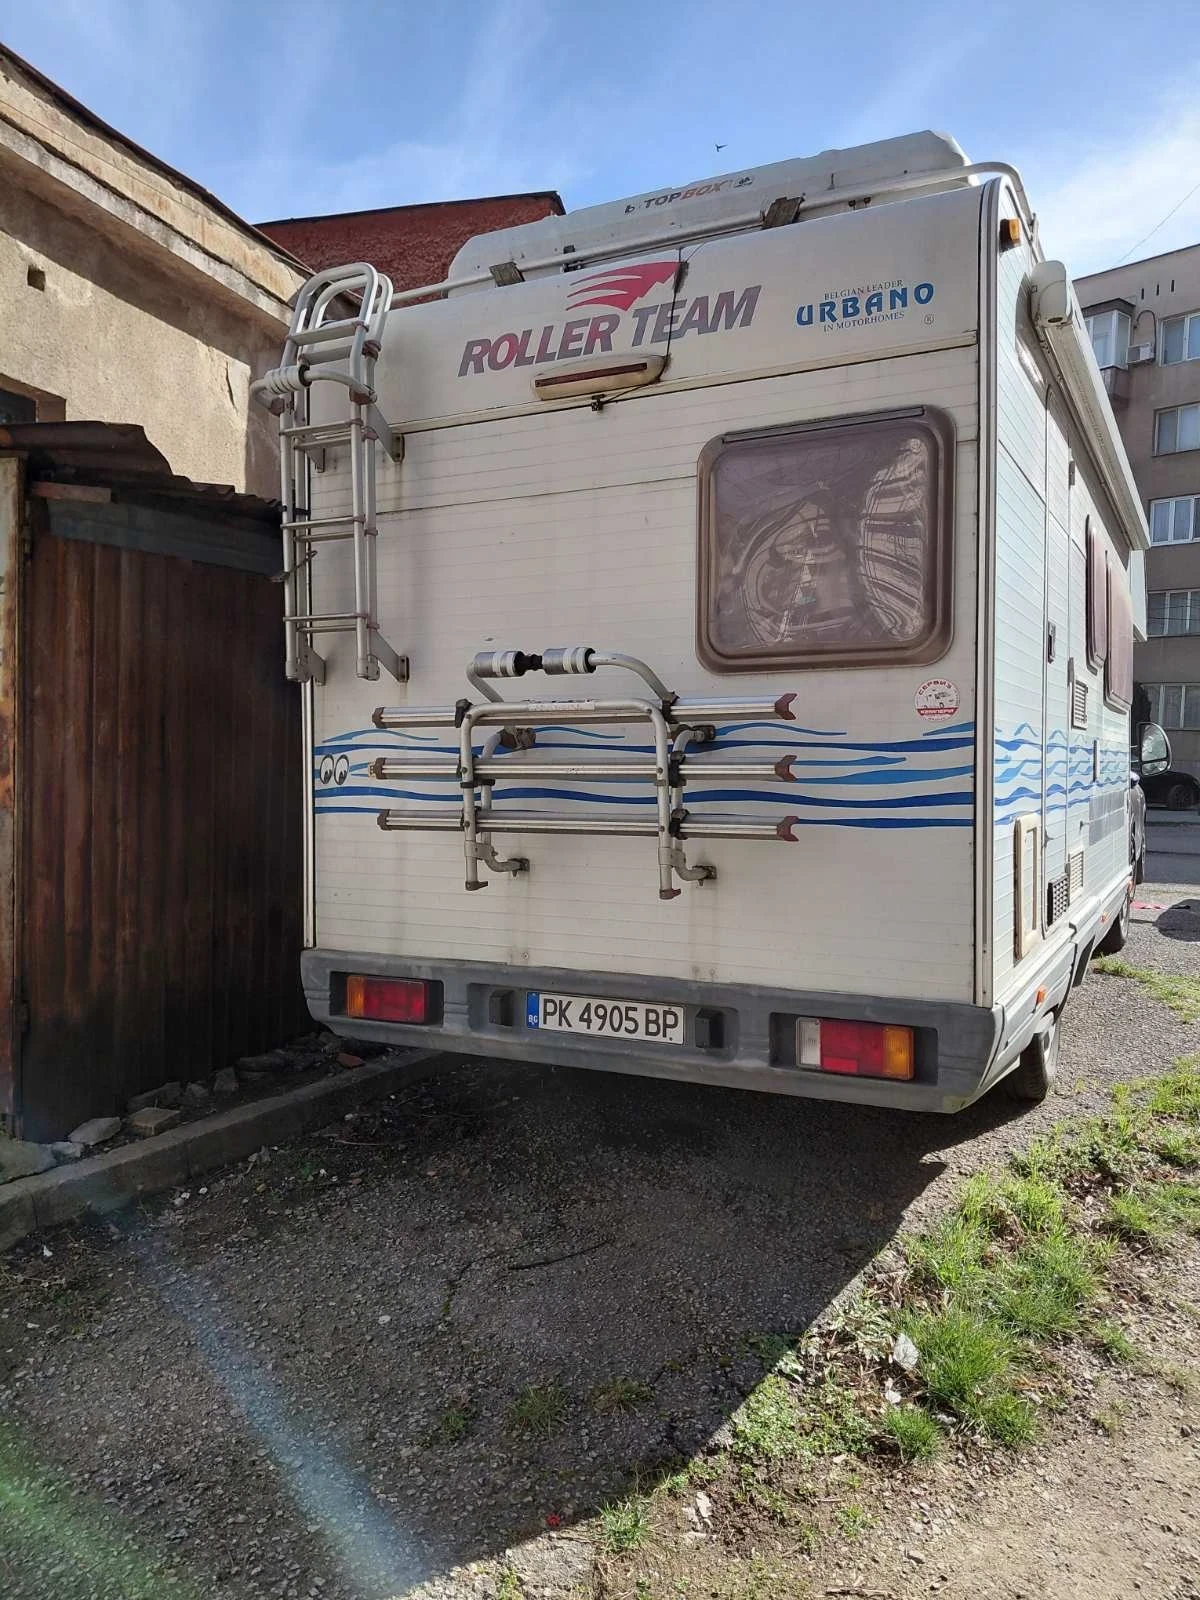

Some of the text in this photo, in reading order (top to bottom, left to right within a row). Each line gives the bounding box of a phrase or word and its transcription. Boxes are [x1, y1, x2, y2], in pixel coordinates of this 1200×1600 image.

[644, 179, 729, 209] TOPBOX
[796, 282, 934, 326] URBANO
[824, 279, 904, 301] BELGIAN LEADER
[457, 285, 762, 377] ROLLER TEAM
[823, 311, 905, 333] IN MOTORHOMES
[528, 998, 679, 1038] BG PK 4905 BP
